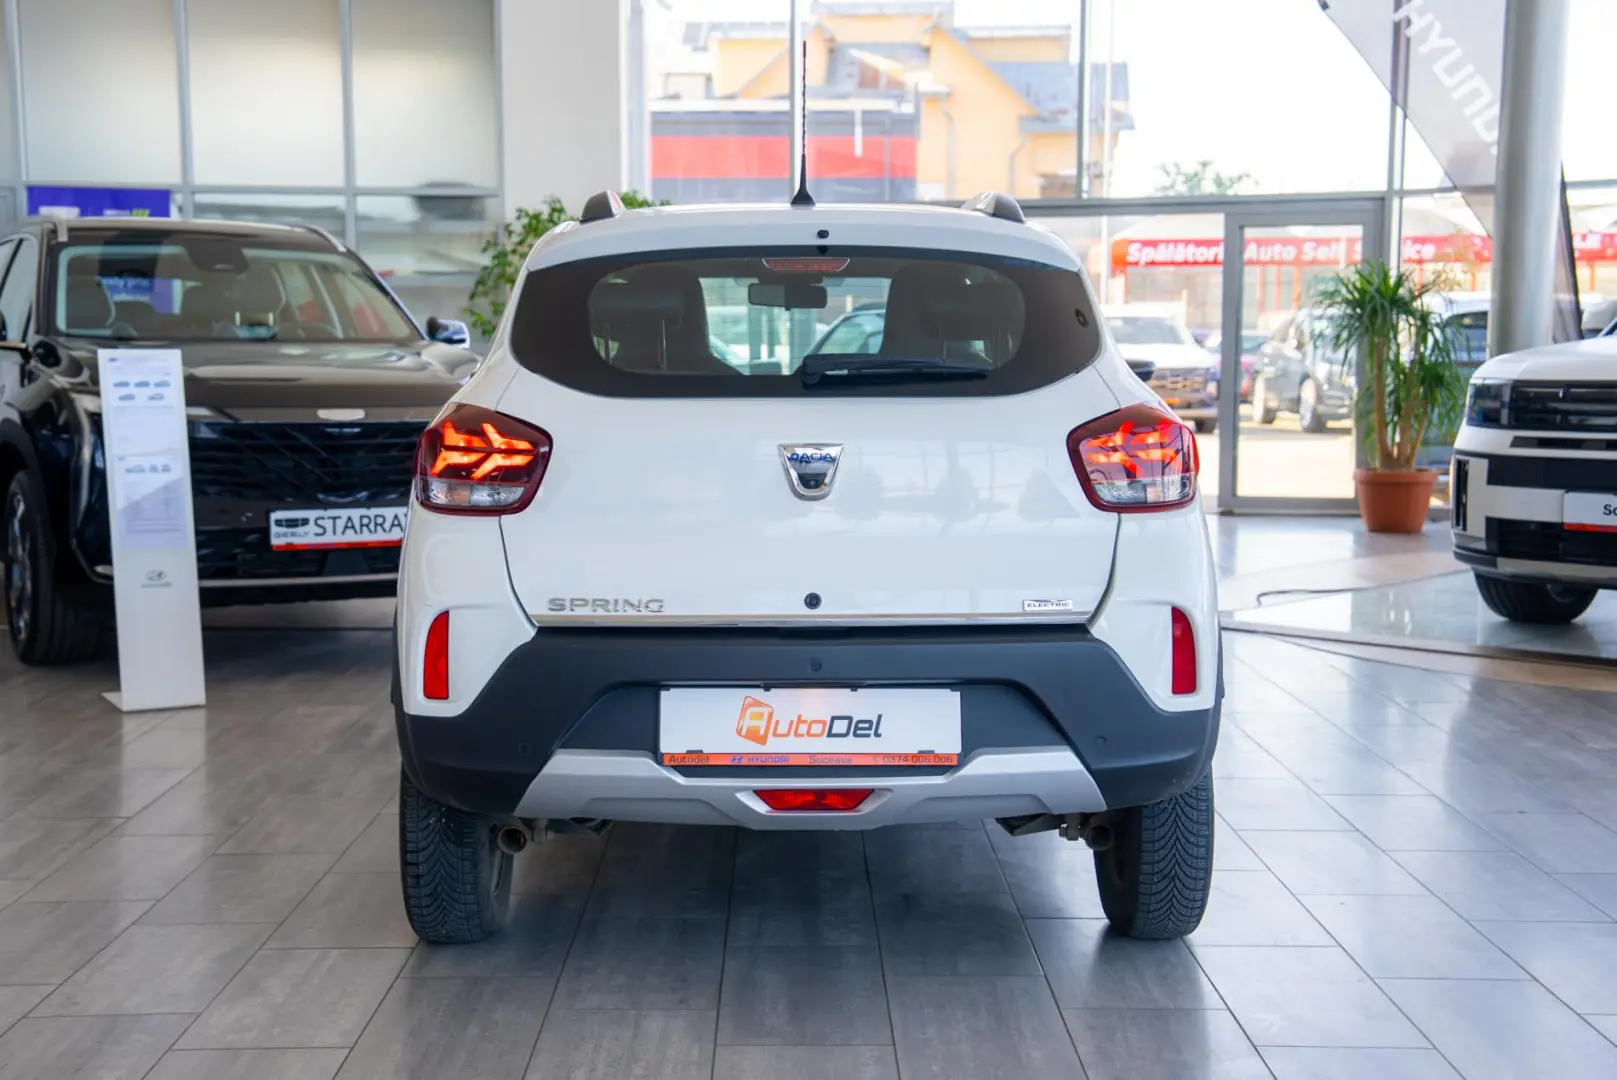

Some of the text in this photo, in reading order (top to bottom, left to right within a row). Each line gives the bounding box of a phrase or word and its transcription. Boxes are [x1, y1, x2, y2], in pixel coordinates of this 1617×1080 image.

[1391, 0, 1499, 155] HYUND
[1243, 241, 1297, 262] Auto
[790, 452, 835, 464] DACIA
[314, 512, 408, 537] STARRA
[548, 598, 665, 613] SPRING
[739, 706, 883, 738] AutoDel
[668, 754, 709, 764] Autodel
[747, 755, 790, 764] HYUNDAI
[809, 755, 853, 765] Suceava
[882, 755, 909, 764] 0374
[933, 755, 953, 764] 006
